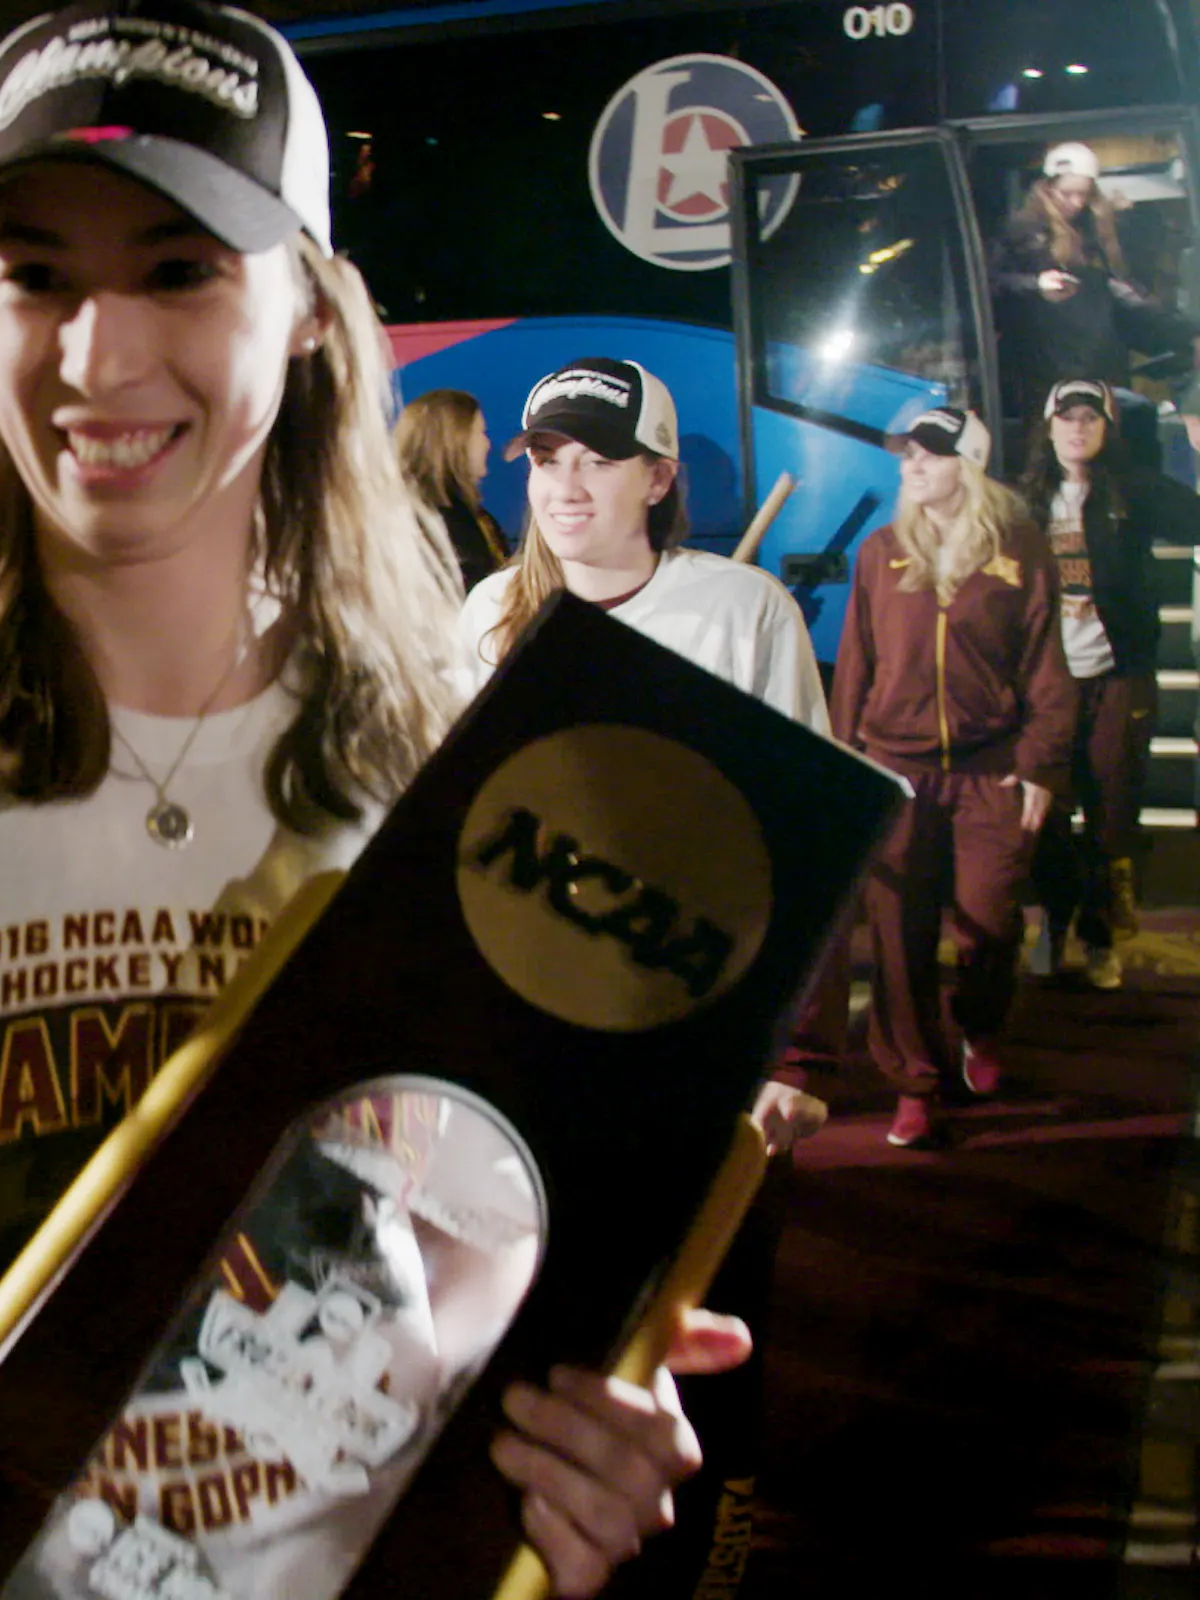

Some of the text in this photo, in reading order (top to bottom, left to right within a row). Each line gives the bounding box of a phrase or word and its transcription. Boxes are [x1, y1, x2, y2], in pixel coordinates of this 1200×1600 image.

[843, 2, 913, 40] 010
[474, 806, 735, 998] NCAA
[61, 909, 177, 948] NCAA
[0, 951, 185, 1007] HOCKEY
